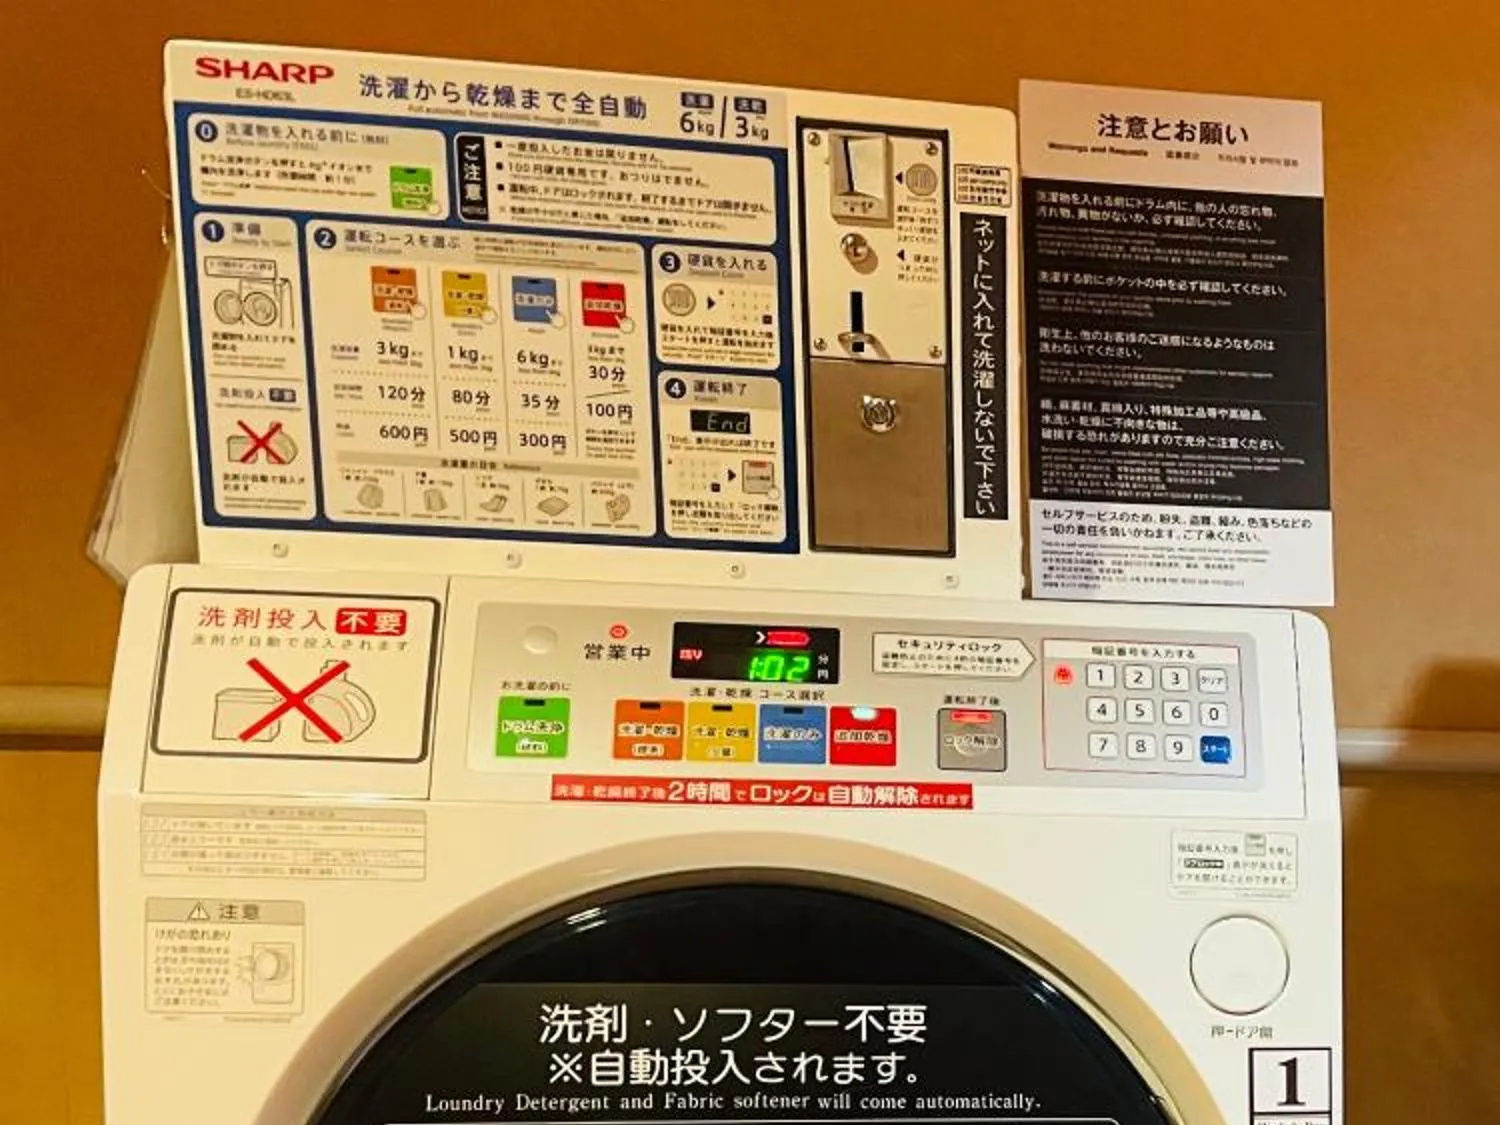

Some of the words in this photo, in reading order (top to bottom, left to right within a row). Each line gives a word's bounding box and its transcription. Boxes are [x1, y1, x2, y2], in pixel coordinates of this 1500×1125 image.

[195, 57, 334, 84] SHARP
[359, 72, 647, 121] 洗濯から乾燥まで全自動
[1097, 113, 1249, 146] 注意とお願い
[462, 141, 484, 201] ご注意
[320, 229, 332, 245] 2
[343, 228, 461, 250] 運転コースを選ぶ
[665, 255, 676, 270] 3
[688, 254, 768, 271] 硬貨を入れる
[971, 218, 996, 515] ネットに入れて洗濯しないで下さい
[669, 382, 681, 397] 4
[693, 379, 748, 396] 運転終了
[707, 411, 749, 434] End
[199, 605, 328, 632] 洗剤投入
[340, 610, 403, 635] 不要
[191, 634, 410, 652] 洗剤が自動で投入されます
[584, 643, 651, 661] 営業中
[898, 639, 1002, 653] セキュリティロック
[1092, 646, 1195, 659] 暗証番号を入力する
[219, 903, 260, 921] 注意
[538, 1003, 928, 1044] 洗剤・ソフター不要
[549, 1048, 919, 1087] ※自動投入されます。
[1277, 1057, 1305, 1106] 1
[426, 1093, 505, 1115] Loundry
[516, 1092, 609, 1113] Detergent
[620, 1092, 653, 1110] and
[664, 1091, 723, 1110] Fabric
[734, 1091, 810, 1109] softener
[818, 1092, 851, 1108] will
[861, 1096, 907, 1109] come
[916, 1092, 1041, 1112] automatically.
